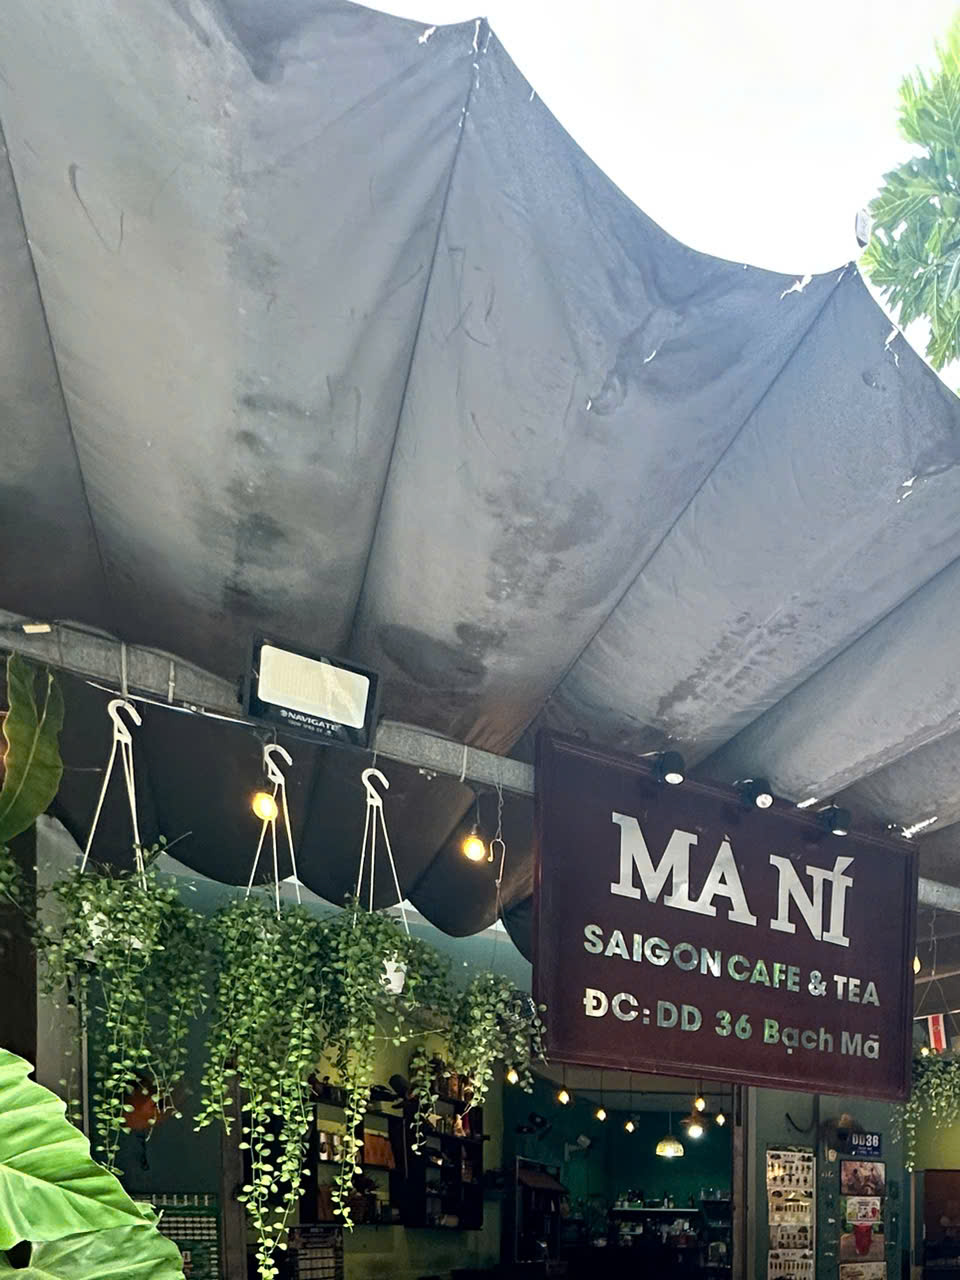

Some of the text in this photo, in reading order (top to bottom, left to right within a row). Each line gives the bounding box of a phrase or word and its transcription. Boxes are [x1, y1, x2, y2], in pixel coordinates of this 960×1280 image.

[769, 855, 855, 948] NÍ
[583, 924, 881, 1007] SAIGON CAFE & TEA
[715, 1010, 753, 1040] 36
[763, 1018, 833, 1055] Bạch
[841, 1033, 880, 1060] Mã
